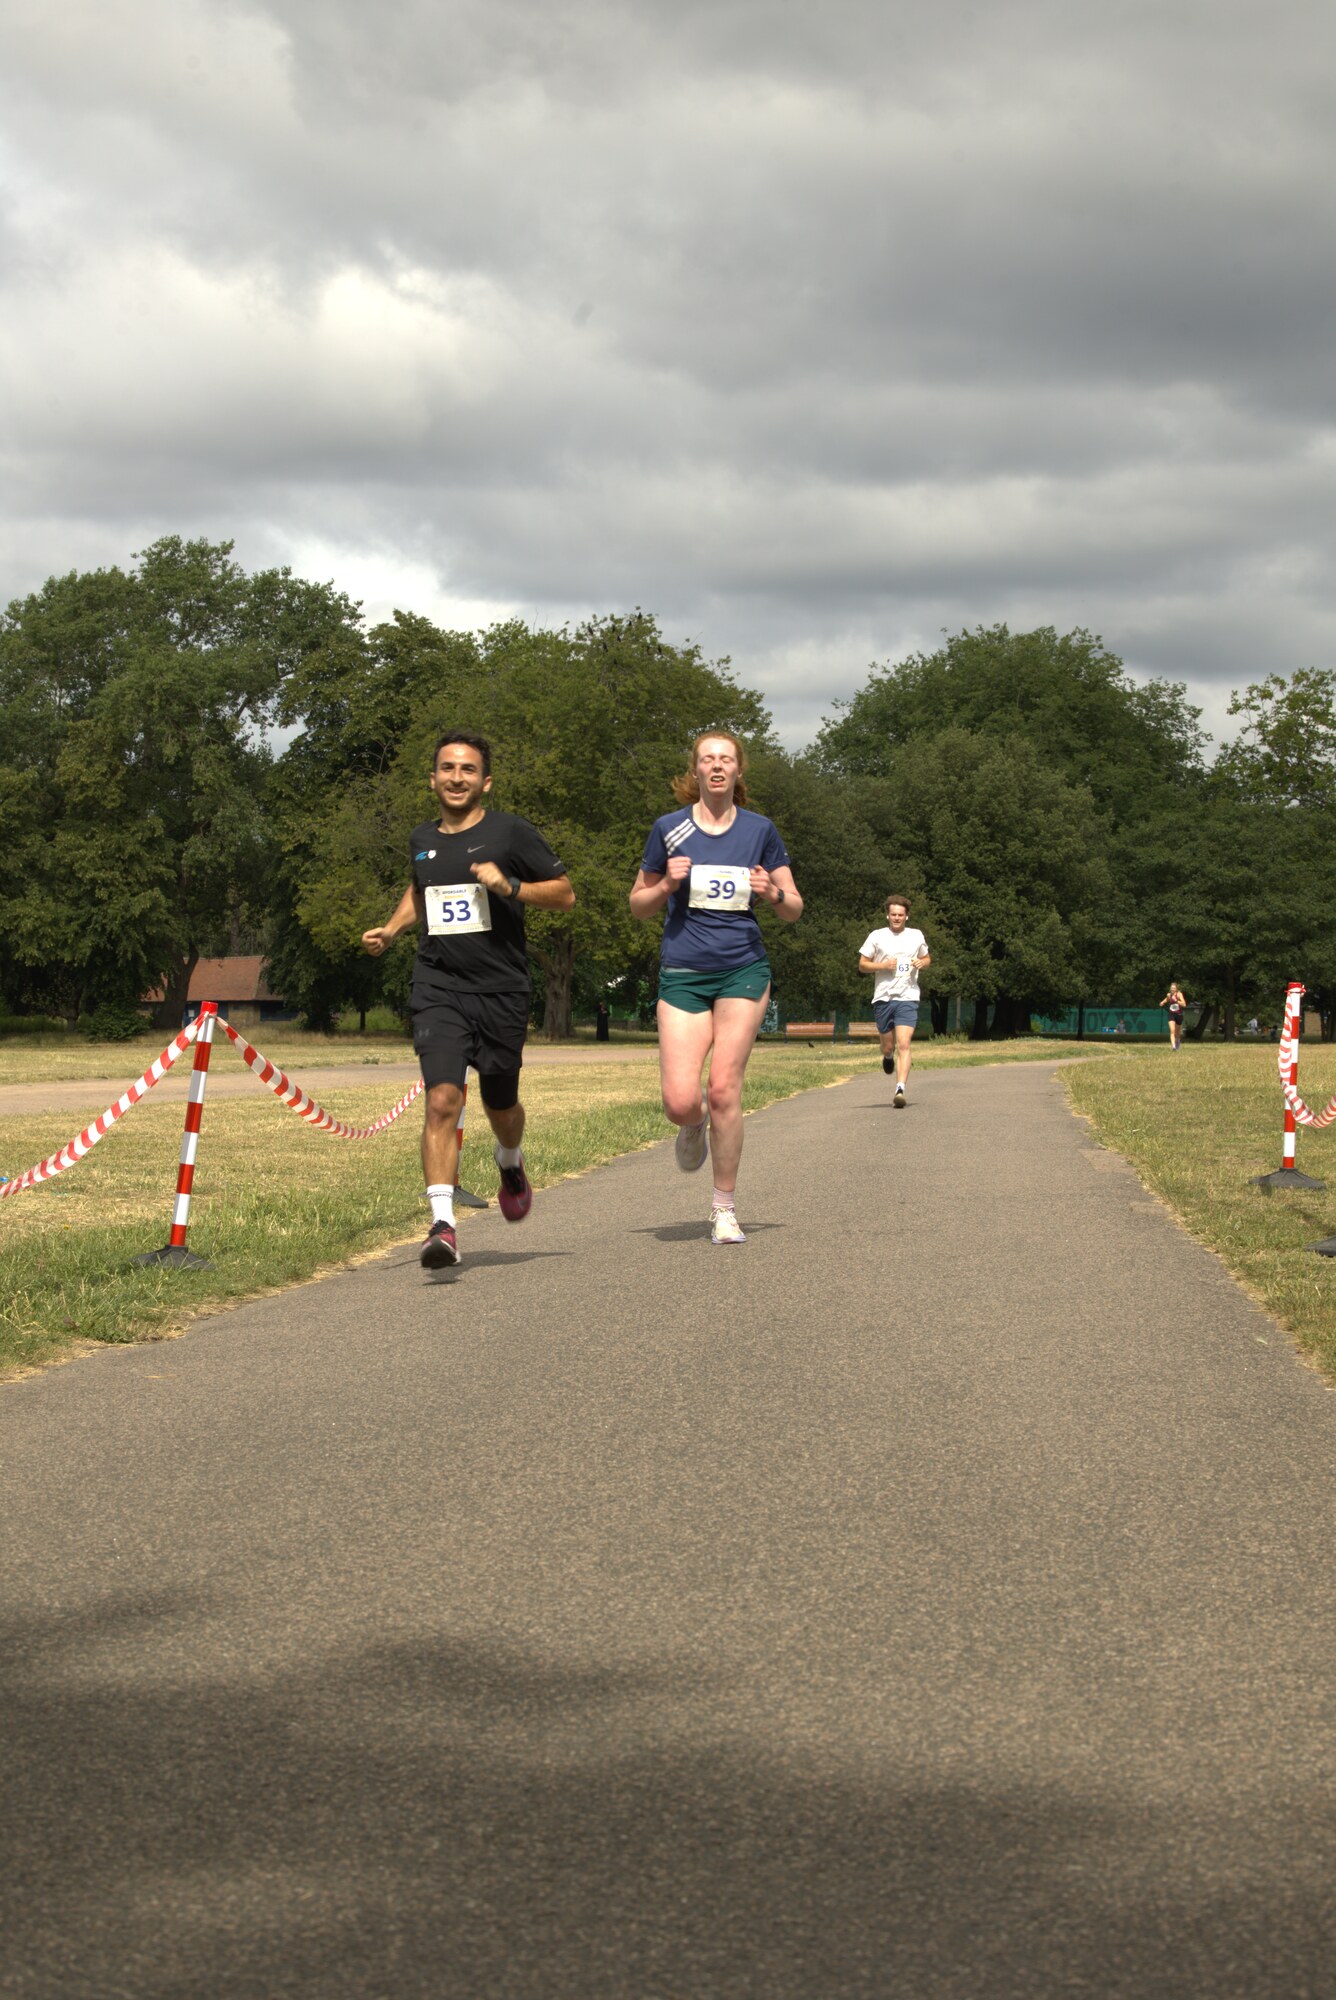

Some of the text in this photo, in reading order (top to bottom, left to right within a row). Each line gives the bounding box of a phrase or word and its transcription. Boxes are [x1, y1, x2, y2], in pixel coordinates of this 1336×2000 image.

[706, 879, 736, 900] 39
[442, 900, 471, 923] 53
[898, 963, 910, 972] 63
